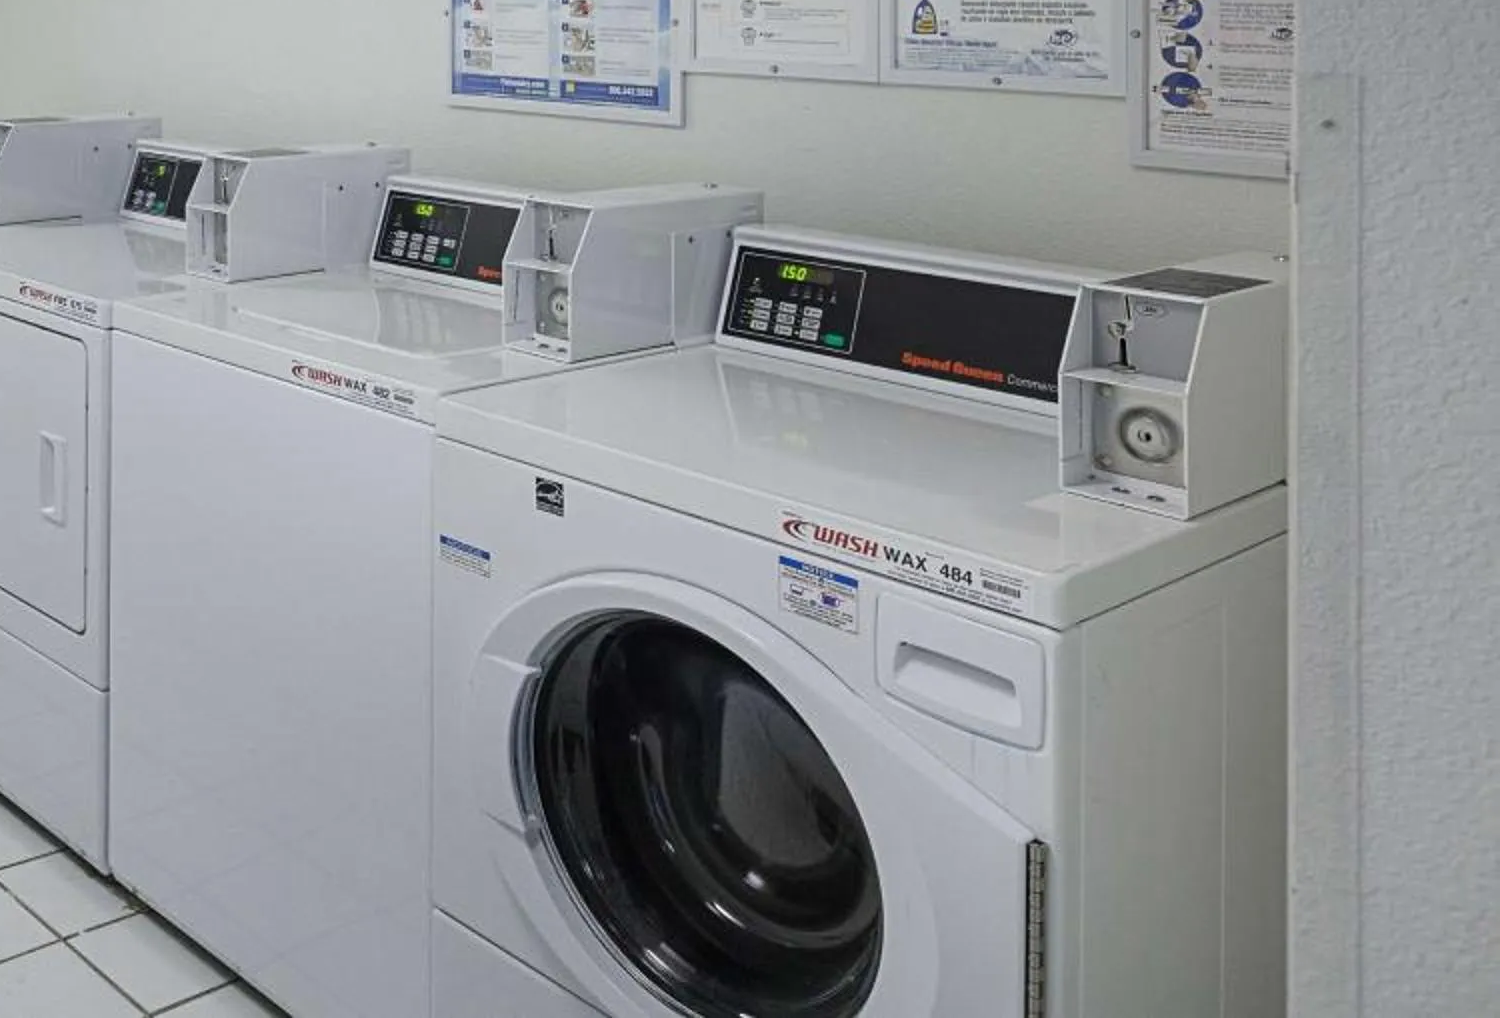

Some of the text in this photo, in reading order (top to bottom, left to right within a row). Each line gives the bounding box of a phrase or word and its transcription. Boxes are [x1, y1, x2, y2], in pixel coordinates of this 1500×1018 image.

[307, 368, 342, 387] WASH
[344, 377, 368, 393] WAX
[901, 351, 951, 373] Speed
[952, 360, 1005, 384] Queen
[813, 524, 973, 586] WASH WAX 484
